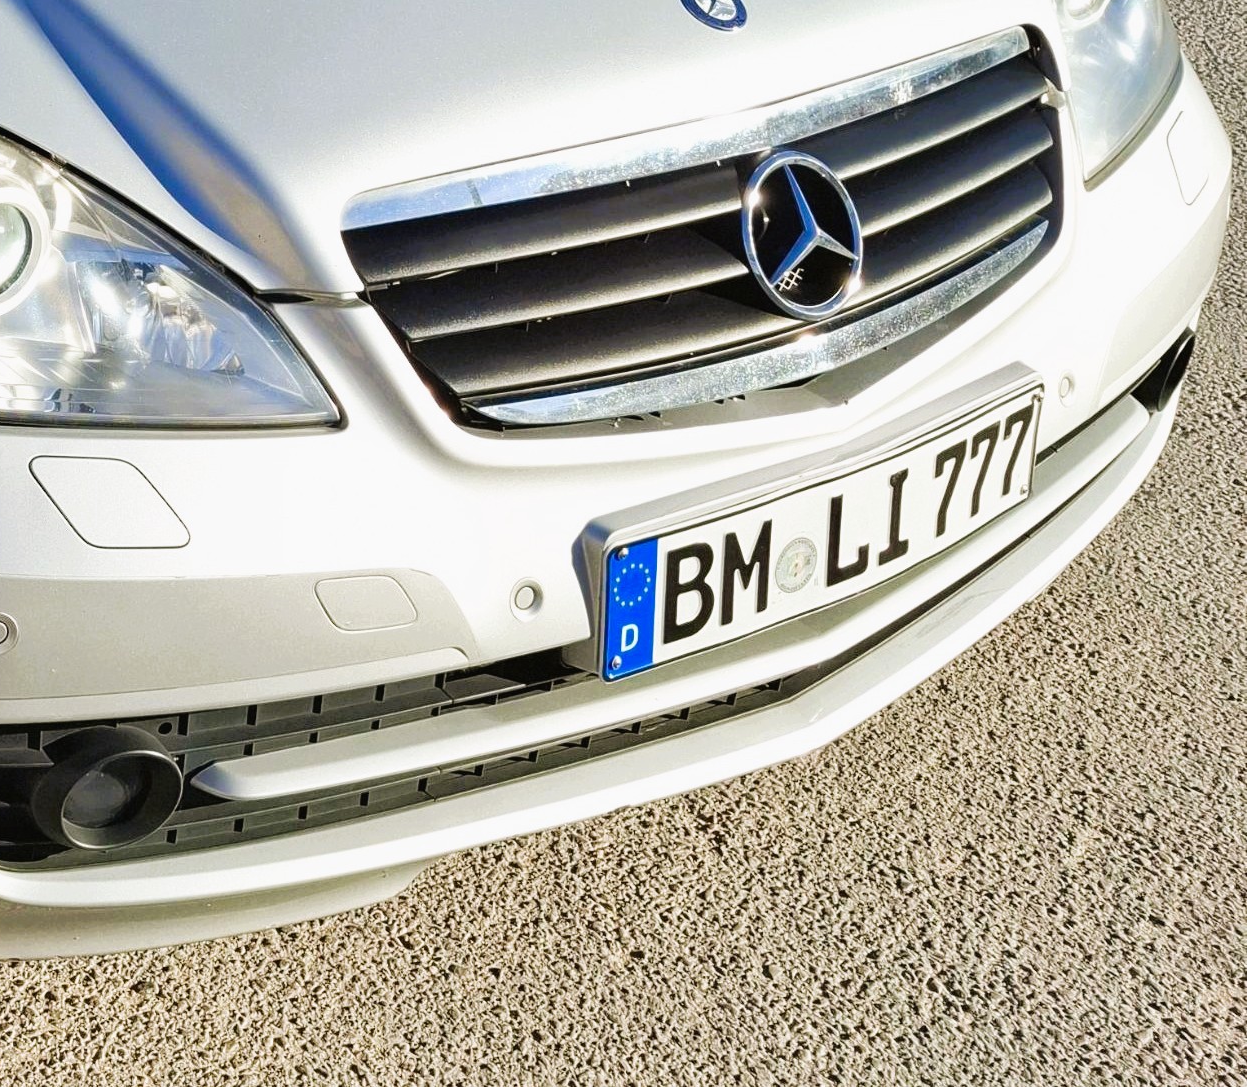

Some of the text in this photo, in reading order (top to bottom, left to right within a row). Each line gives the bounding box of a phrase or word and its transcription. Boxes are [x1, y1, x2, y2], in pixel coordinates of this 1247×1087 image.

[662, 519, 773, 644] BM
[826, 468, 909, 588] LI
[933, 404, 1034, 538] 777
[619, 623, 640, 653] D
